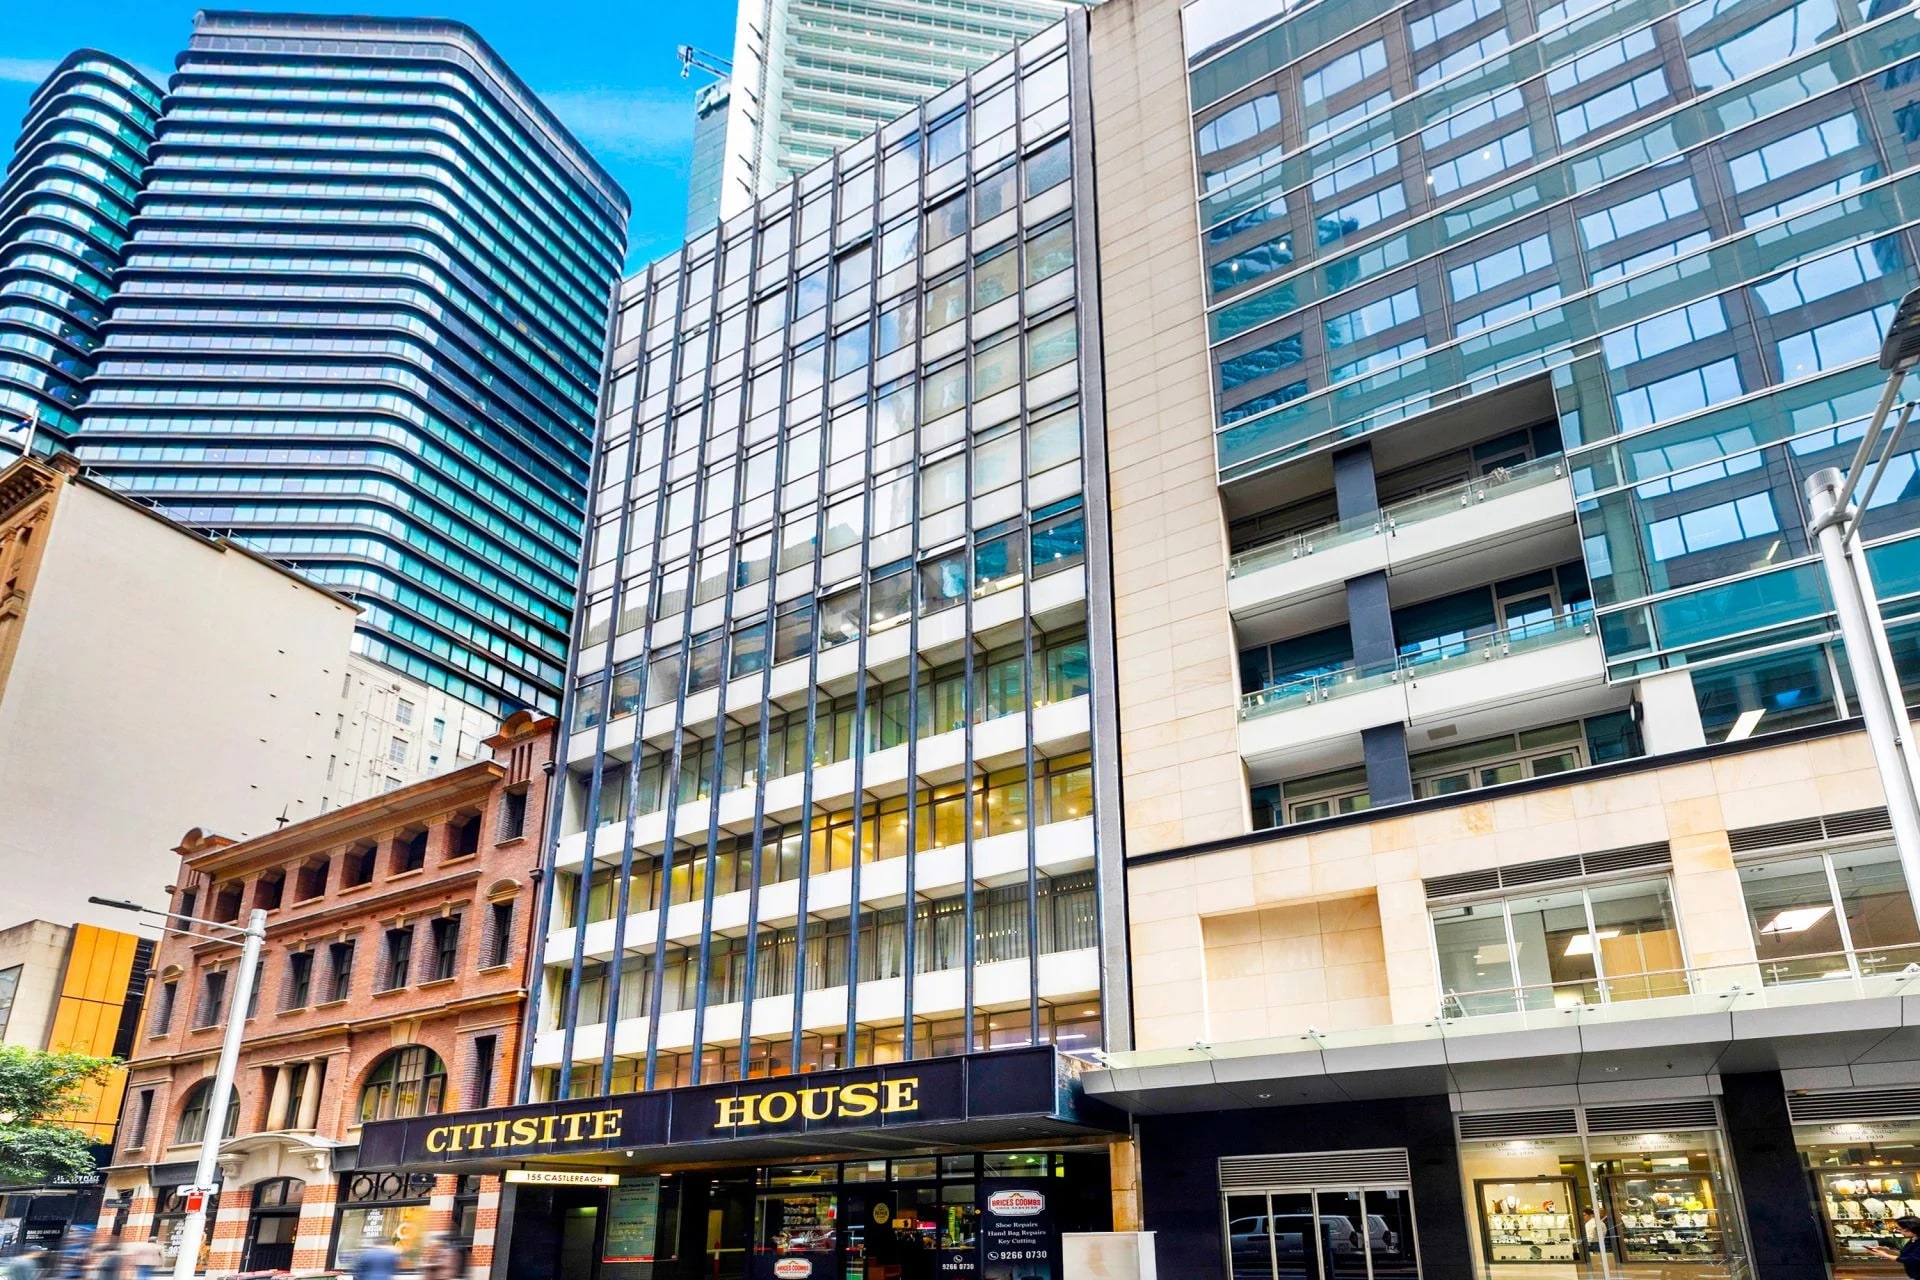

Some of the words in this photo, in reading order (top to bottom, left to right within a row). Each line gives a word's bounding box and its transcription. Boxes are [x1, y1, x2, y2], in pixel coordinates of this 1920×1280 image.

[426, 1109, 623, 1153] CITISITE
[713, 1077, 919, 1128] HOUSE
[526, 1173, 542, 1181] 155
[544, 1173, 604, 1183] CASTLEREAGH
[1015, 1198, 1041, 1206] COOMBS
[1000, 1251, 1023, 1259] 9266
[1025, 1250, 1047, 1259] 0730
